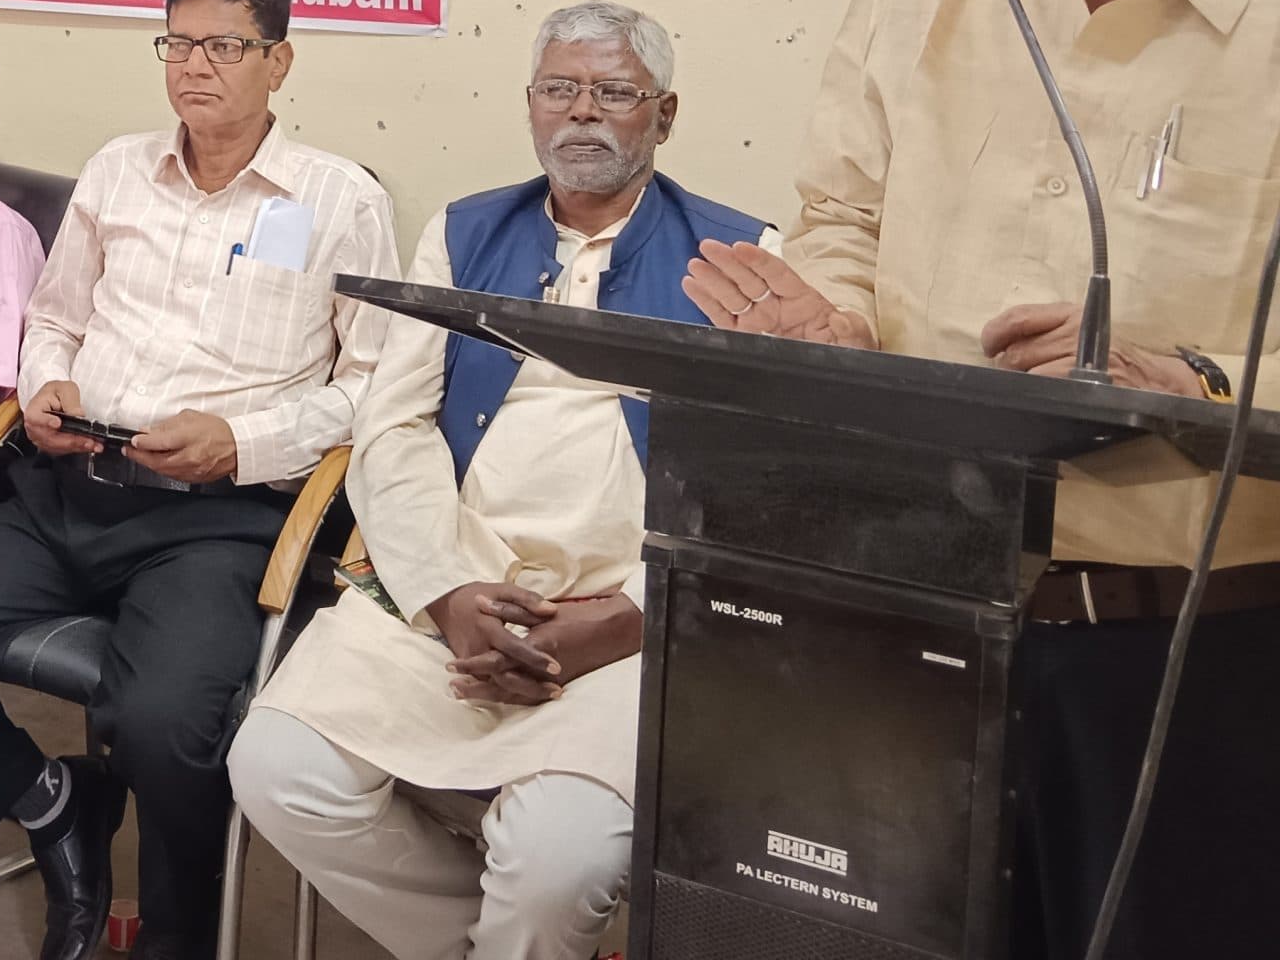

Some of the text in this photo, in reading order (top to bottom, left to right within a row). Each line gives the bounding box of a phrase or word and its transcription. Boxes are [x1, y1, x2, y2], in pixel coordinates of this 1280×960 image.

[711, 600, 783, 626] WSL-2500R
[767, 835, 848, 871] AHUJA
[736, 862, 879, 913] PA LECTERN SYSTEM
